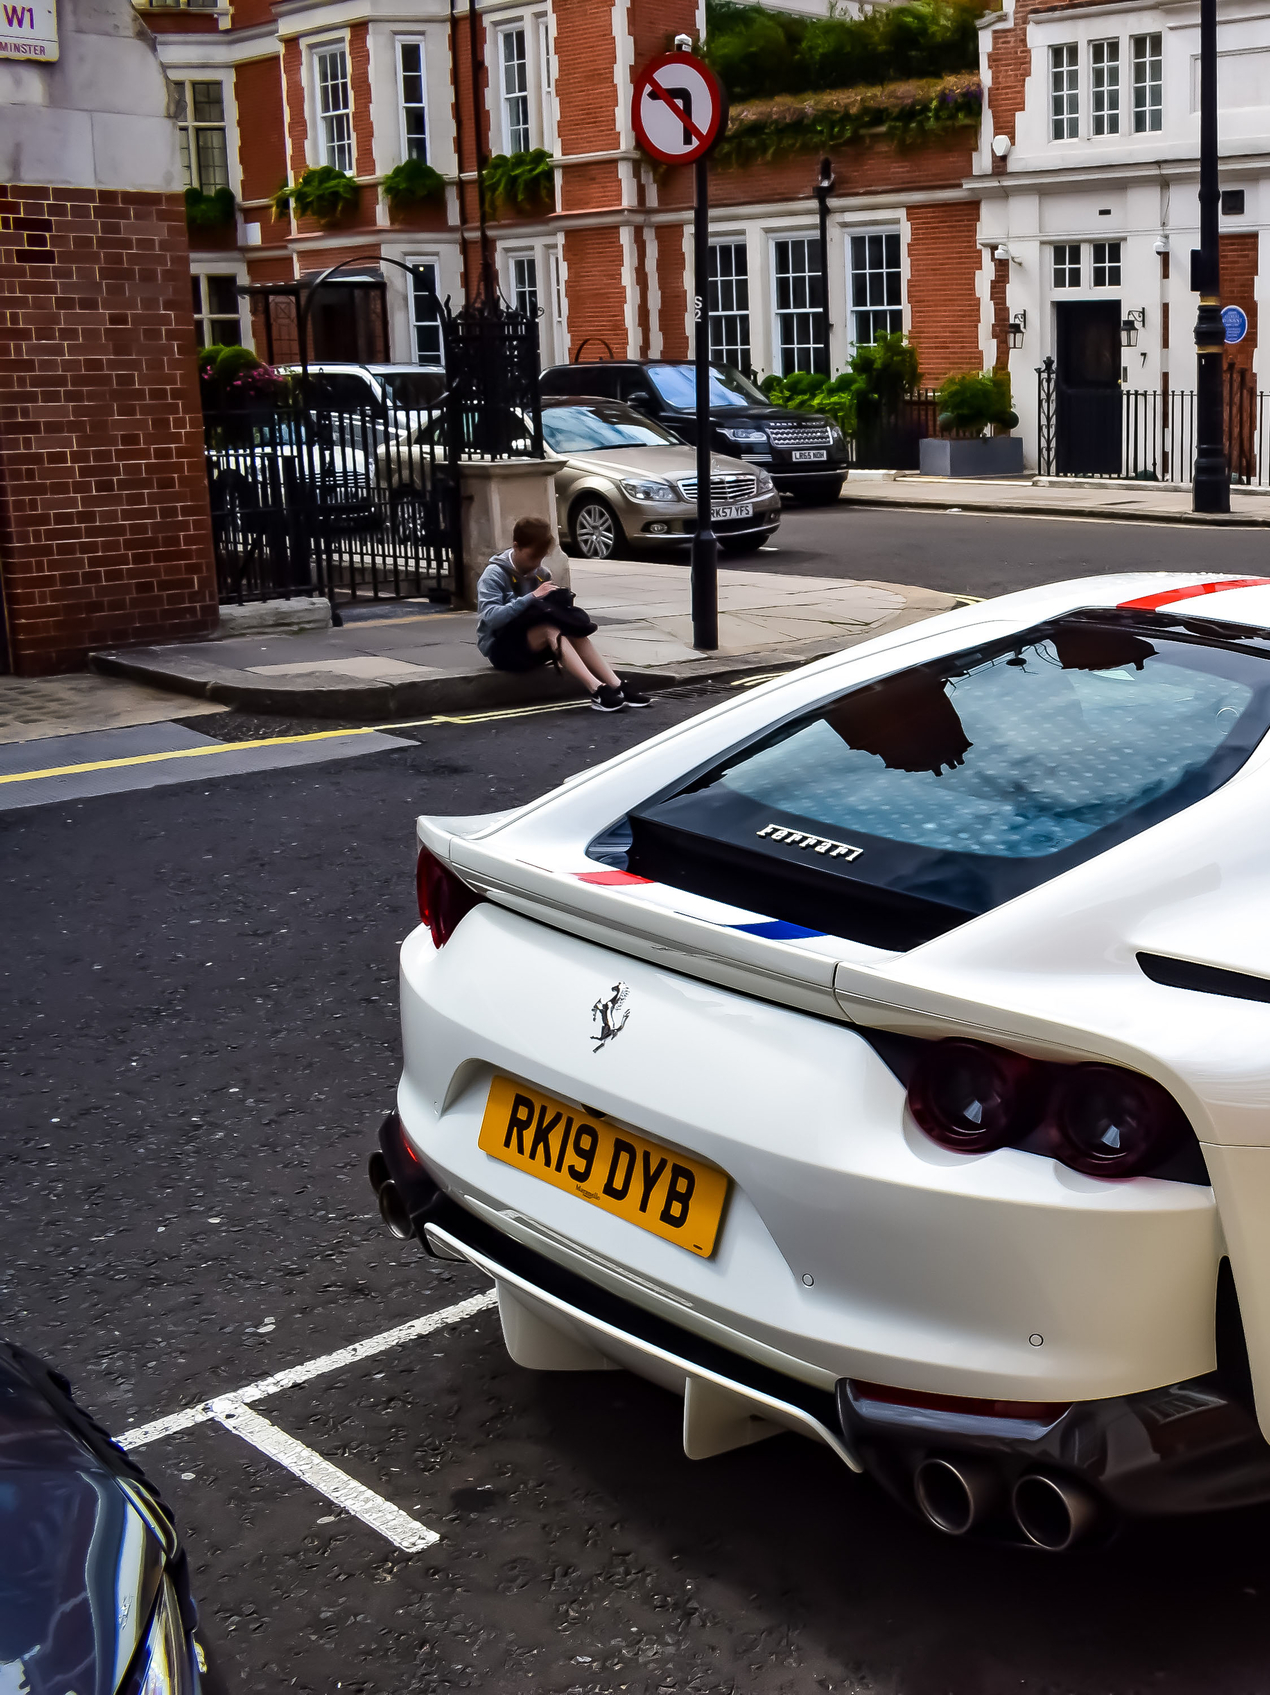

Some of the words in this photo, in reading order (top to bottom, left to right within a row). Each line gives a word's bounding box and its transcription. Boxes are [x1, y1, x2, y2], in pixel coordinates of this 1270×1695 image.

[2, 3, 35, 30] W1
[1140, 352, 1148, 368] 7
[734, 504, 750, 516] YFS
[756, 823, 864, 862] Ferrari
[503, 1092, 600, 1184] RK19
[602, 1136, 696, 1230] DYB
